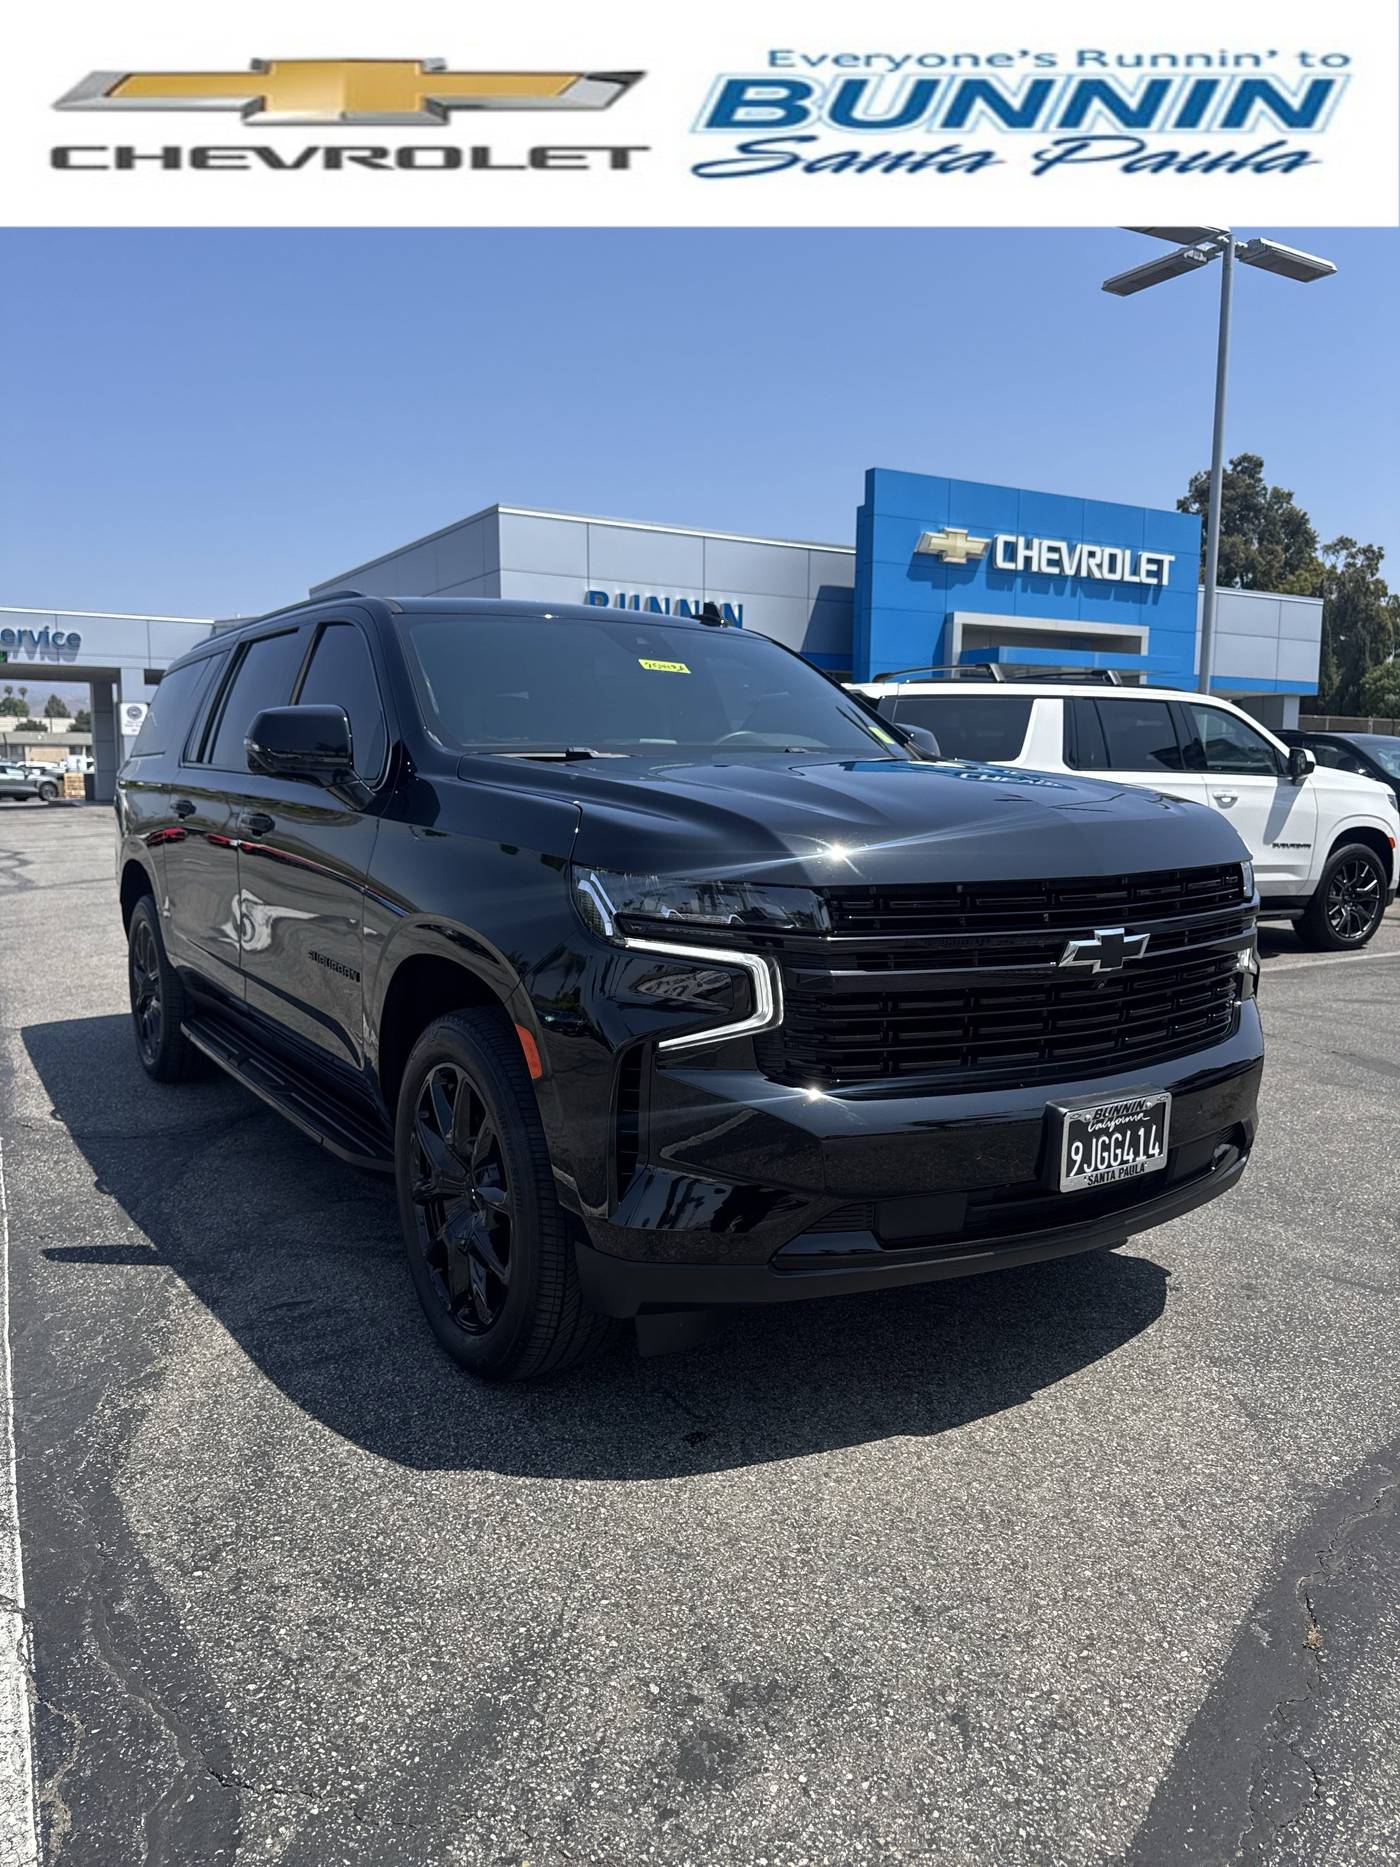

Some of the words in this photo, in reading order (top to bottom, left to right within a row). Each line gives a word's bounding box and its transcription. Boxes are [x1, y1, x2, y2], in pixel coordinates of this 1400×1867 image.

[993, 533, 1176, 586] CHEVROLET
[586, 590, 743, 628] BUNNN
[0, 625, 82, 651] ervice
[308, 950, 361, 983] SUBURBAN
[1088, 1112, 1151, 1133] California
[1093, 1099, 1147, 1120] BUNNIN
[1069, 1124, 1161, 1177] 9JGG414
[1086, 1168, 1117, 1186] SANTA
[1118, 1162, 1146, 1179] PAULA
